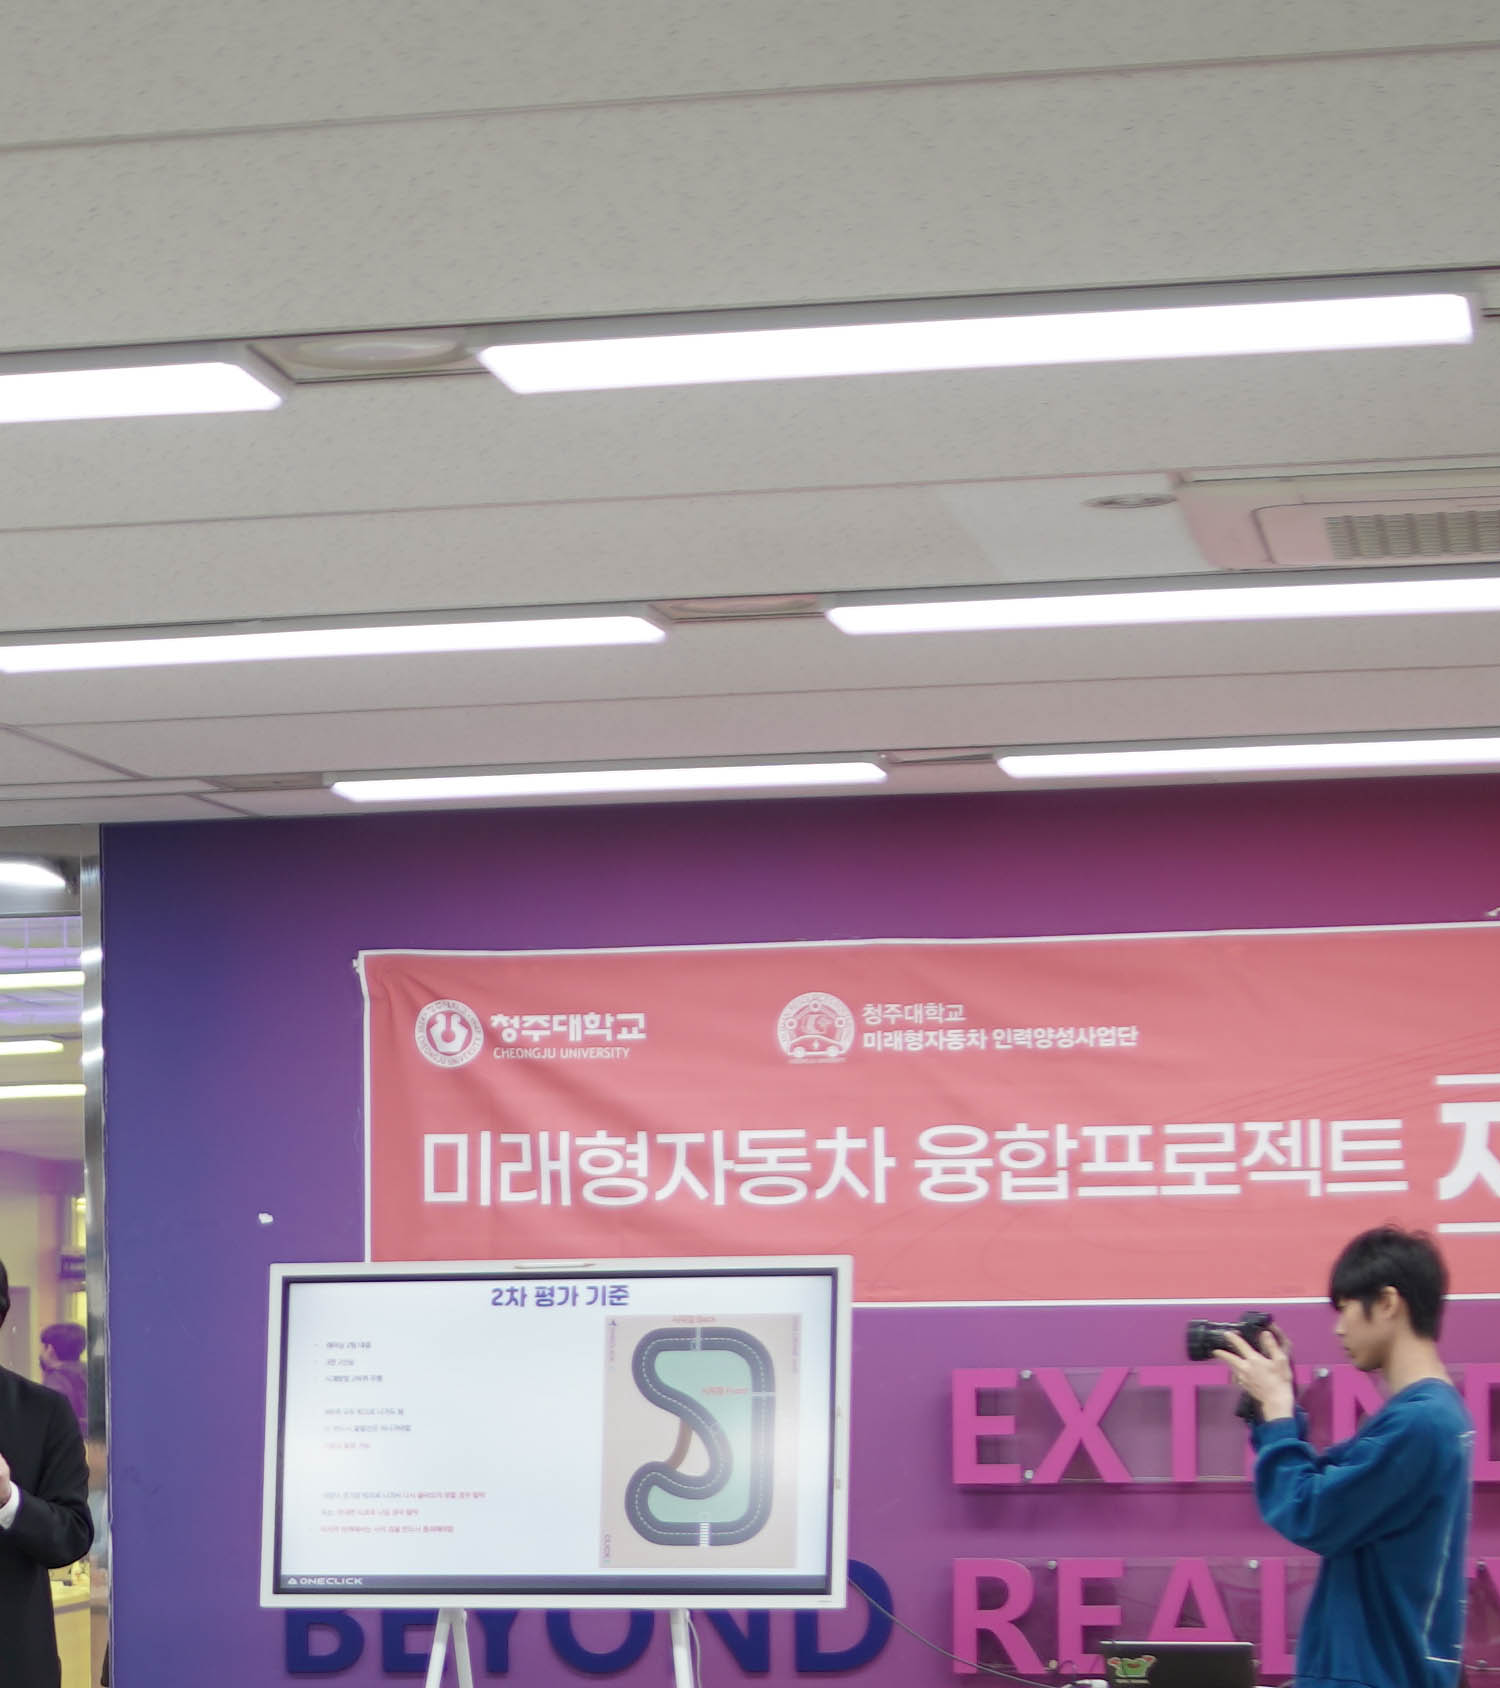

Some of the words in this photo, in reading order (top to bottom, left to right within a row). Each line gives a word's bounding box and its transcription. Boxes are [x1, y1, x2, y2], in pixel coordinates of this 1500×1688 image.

[862, 1003, 966, 1024] 청주대학교
[490, 1012, 647, 1043] 청주대학교
[862, 1028, 988, 1051] 미래형자동차
[992, 1026, 1140, 1050] 인력양성사업단
[493, 1047, 555, 1059] CHEONGJU
[560, 1047, 630, 1059] UNIVERSITY
[423, 1127, 896, 1206] 미래형자동차
[917, 1118, 1407, 1200] 융합프로젝트
[491, 1286, 527, 1307] 2차
[534, 1285, 578, 1307] 평가
[585, 1284, 630, 1306] 기준
[300, 1577, 362, 1585] ONECLICK
